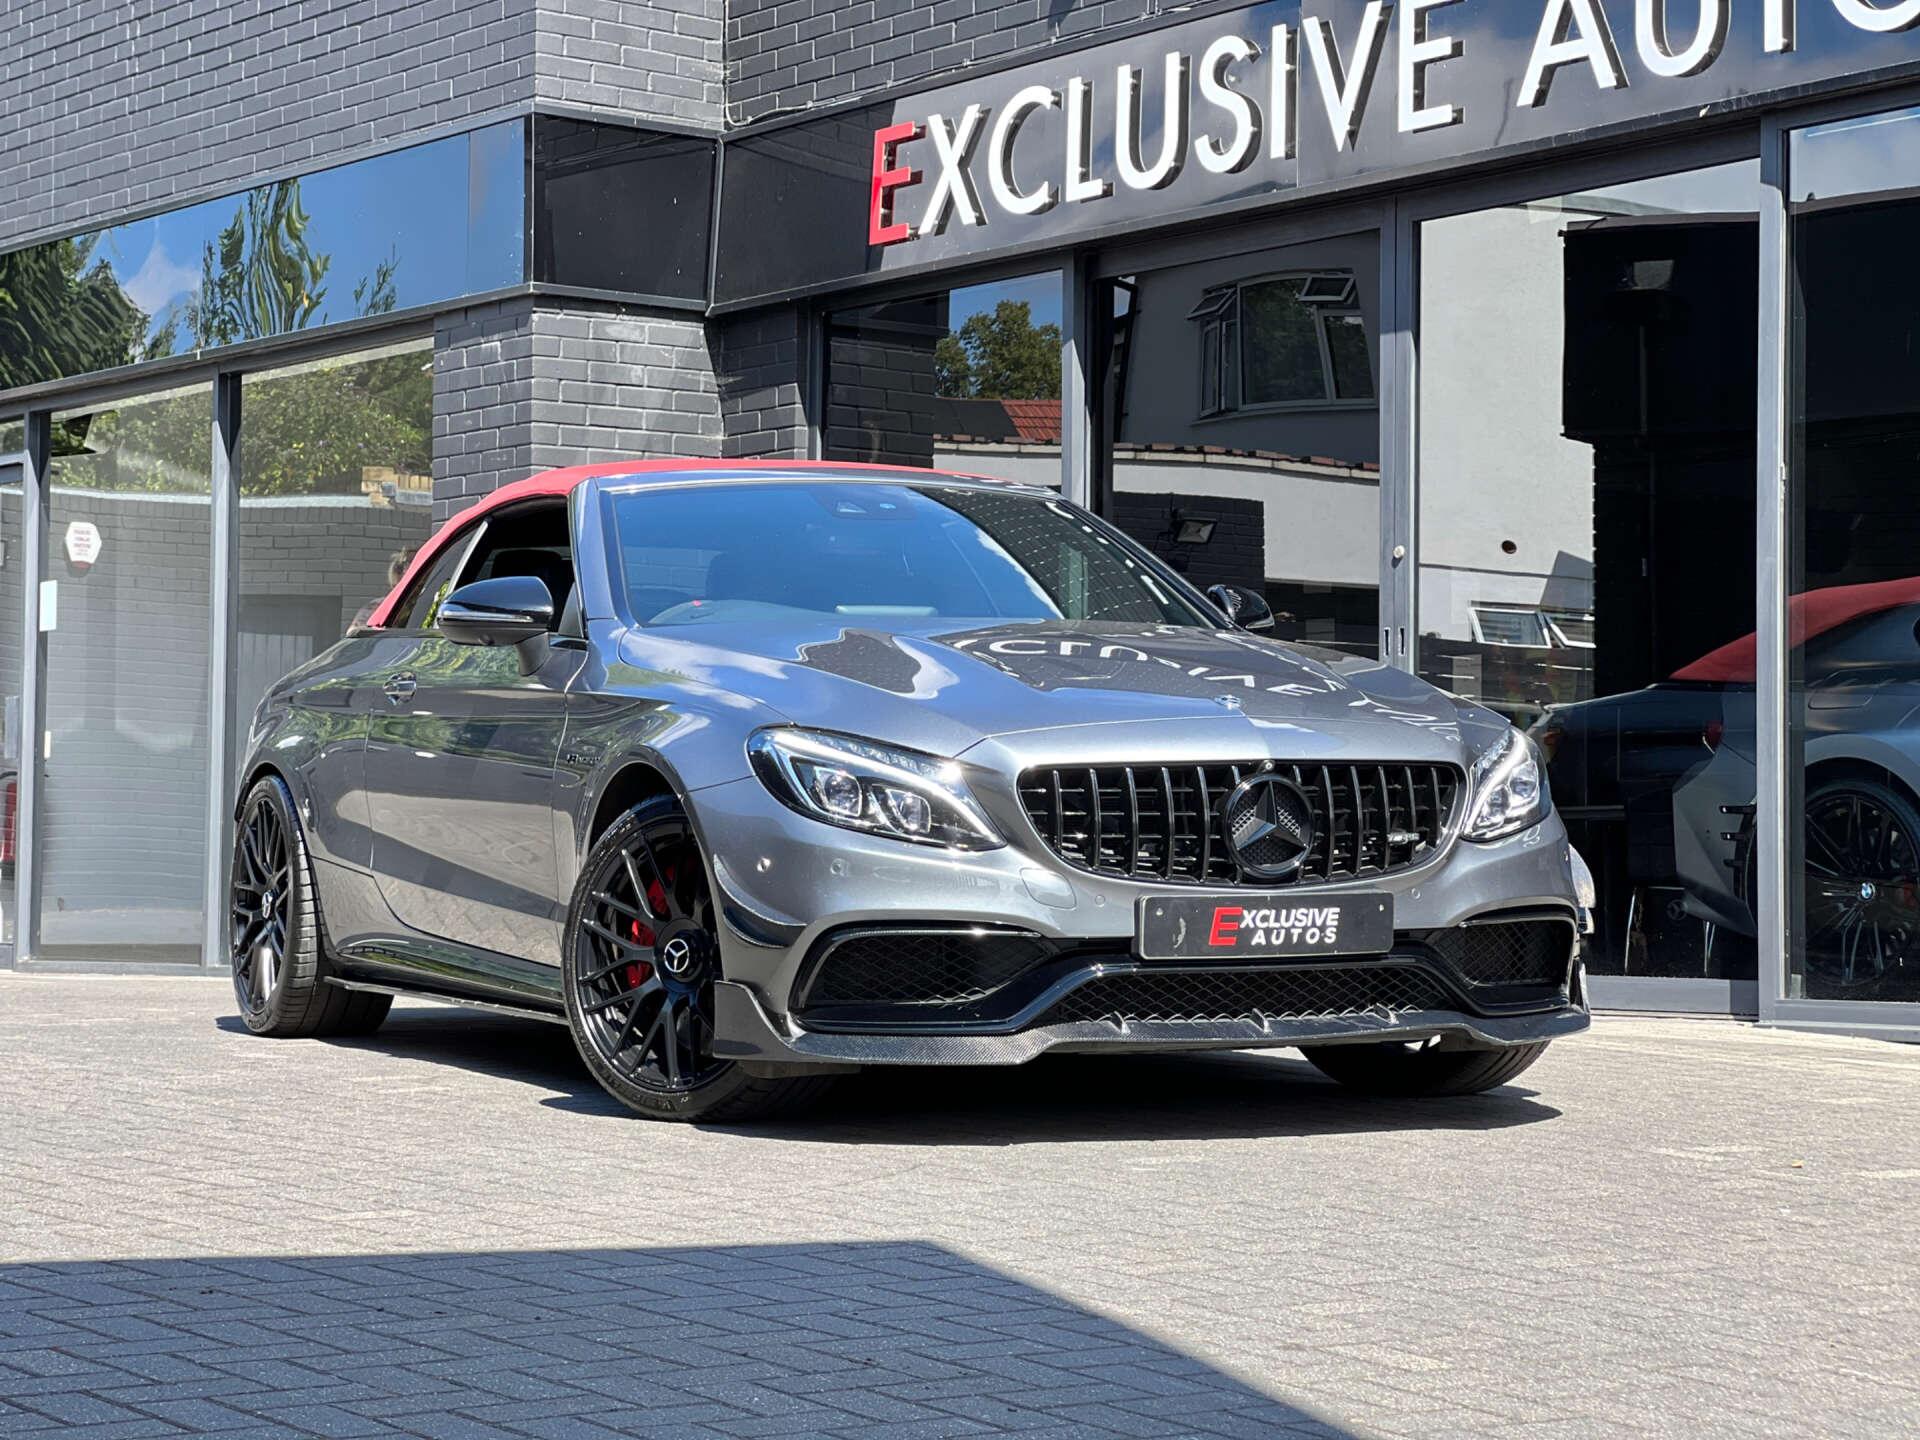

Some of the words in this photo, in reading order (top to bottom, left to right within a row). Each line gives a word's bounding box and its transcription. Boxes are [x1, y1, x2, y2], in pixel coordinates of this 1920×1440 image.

[868, 0, 1465, 247] EXCLUSIVE
[1208, 906, 1340, 946] EXCLUSIVE
[1250, 927, 1337, 945] AUTOS
